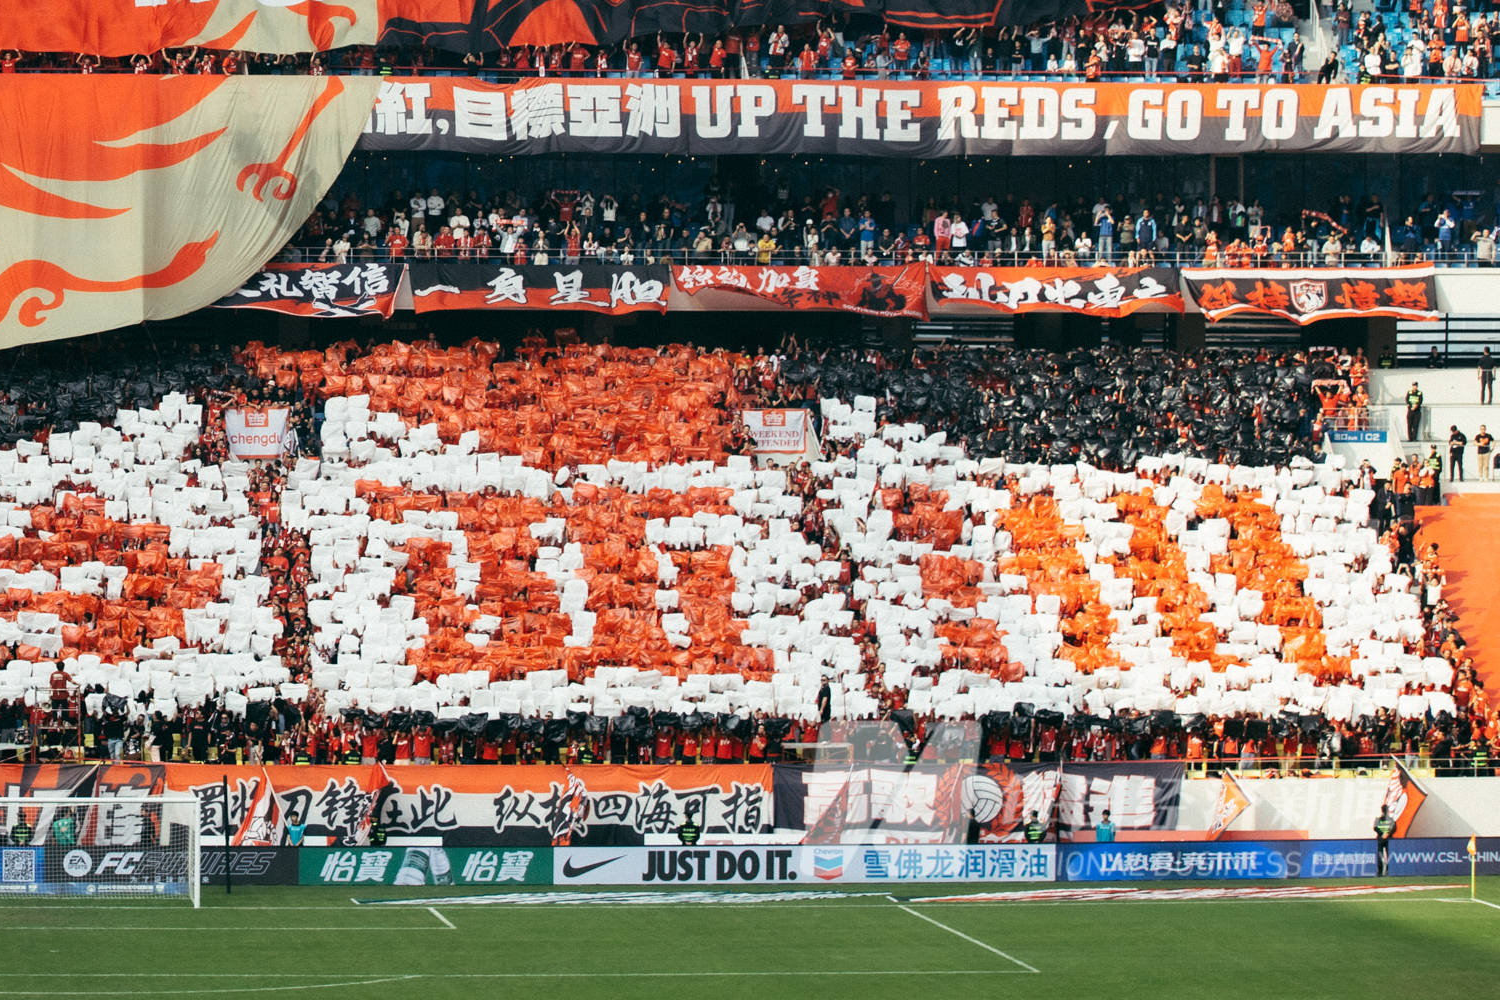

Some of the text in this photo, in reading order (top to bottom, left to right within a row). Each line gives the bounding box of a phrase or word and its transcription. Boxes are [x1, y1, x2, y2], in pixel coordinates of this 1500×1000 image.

[693, 85, 777, 138] UP
[798, 85, 920, 141] THE
[1128, 89, 1200, 141] GO
[1216, 89, 1299, 141] TO
[1314, 88, 1460, 139] ASIA
[230, 432, 282, 450] chengdu
[751, 429, 800, 438] WEEKEND
[754, 438, 800, 447] FFENDER
[1365, 432, 1381, 441] C2
[69, 857, 86, 865] EA
[813, 847, 843, 856] Chevron
[95, 852, 143, 875] FC
[321, 850, 393, 883] 怡寶
[462, 850, 534, 883] 怡寶
[642, 849, 798, 882] JUST DO IT.
[864, 848, 1049, 879] 雪佛龙润滑油
